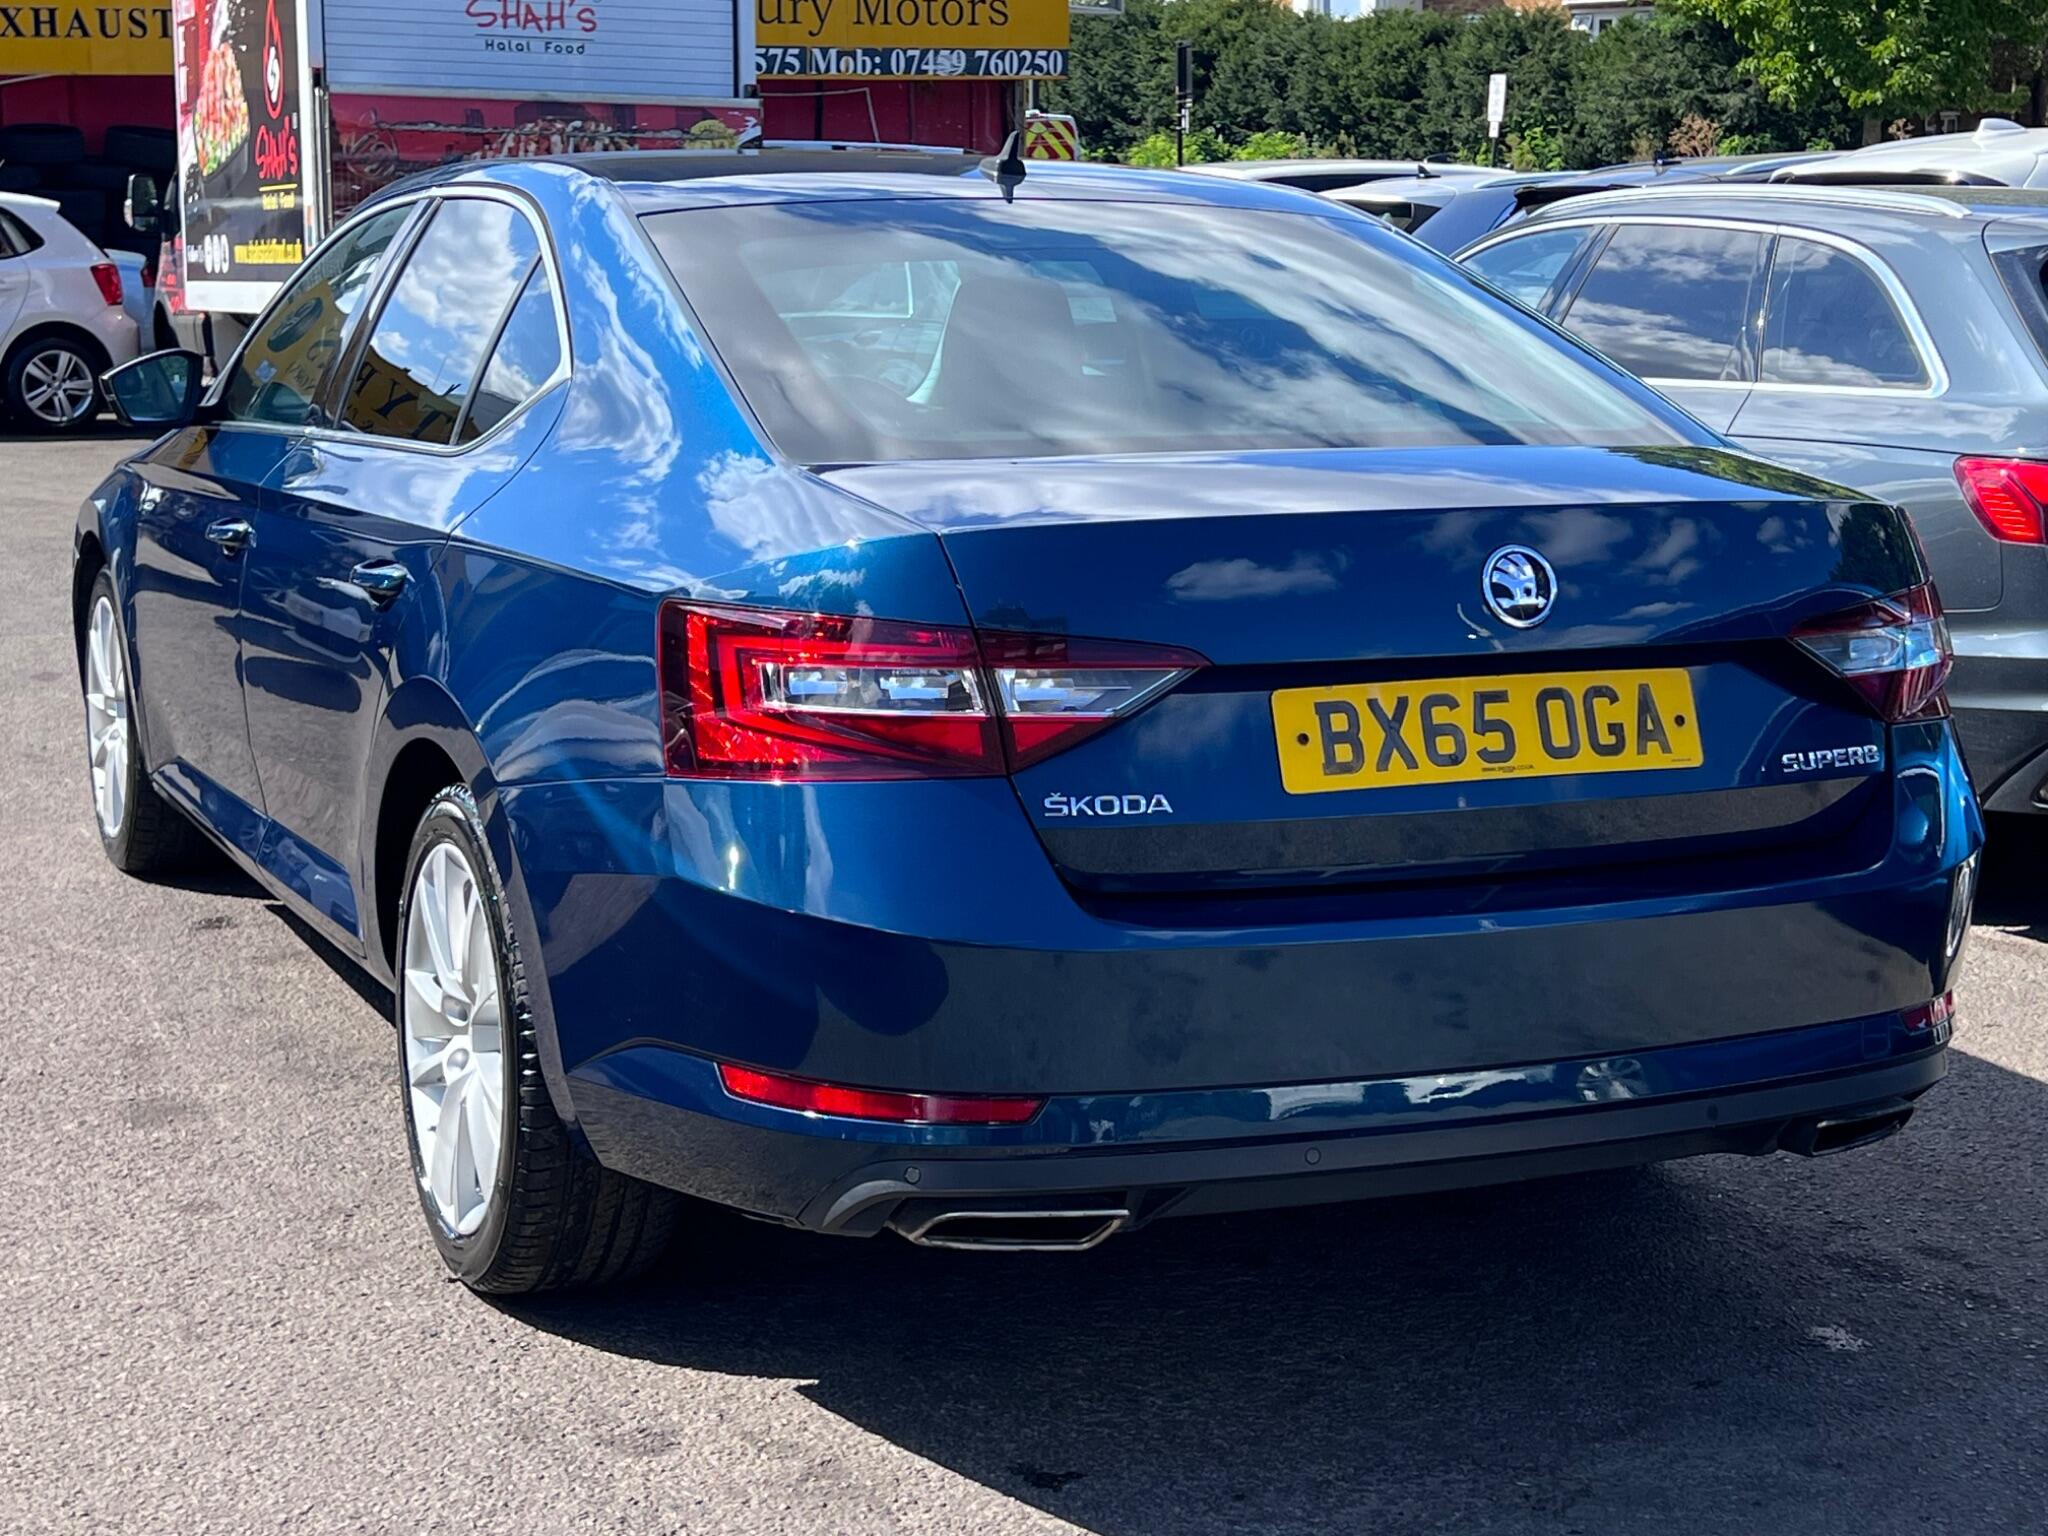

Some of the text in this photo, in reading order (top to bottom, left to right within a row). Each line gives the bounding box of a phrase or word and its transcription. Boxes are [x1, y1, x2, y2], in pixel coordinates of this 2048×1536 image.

[0, 7, 173, 38] XHAUST
[853, 0, 1009, 26] Motors
[485, 40, 585, 55] Halal Food
[812, 48, 881, 75] Mob:
[975, 50, 1063, 76] 760250
[1314, 683, 1673, 776] BX65 OGA
[1782, 745, 1880, 773] SUPERB
[1044, 793, 1173, 817] ŠKODA
